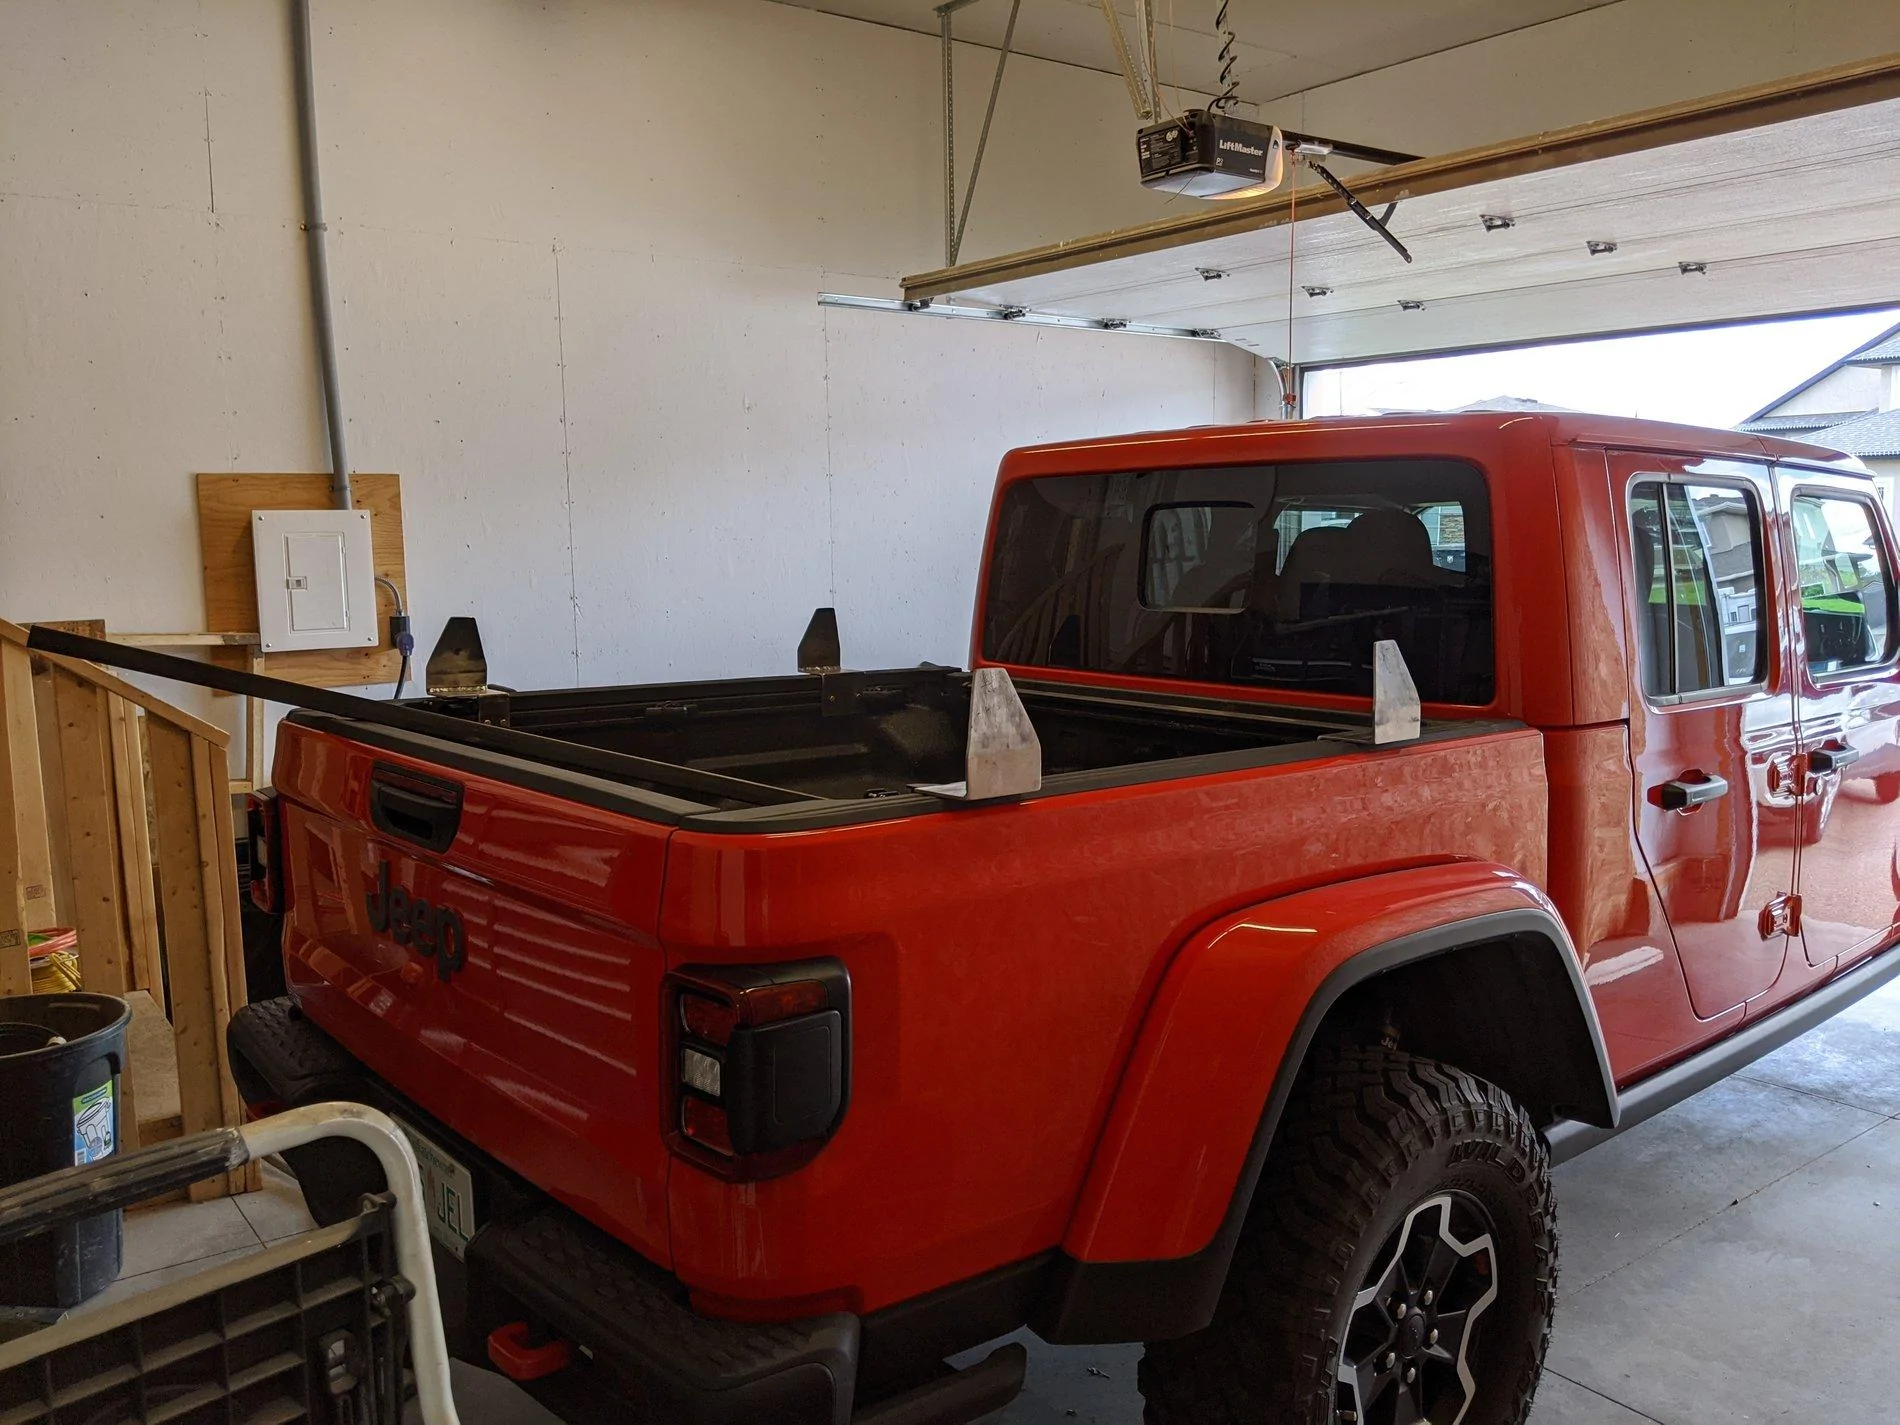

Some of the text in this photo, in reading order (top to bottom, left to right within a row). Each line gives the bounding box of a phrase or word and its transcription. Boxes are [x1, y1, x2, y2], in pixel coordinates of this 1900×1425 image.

[1219, 139, 1263, 156] LiftMaster
[366, 859, 463, 983] Jeep
[438, 1182, 469, 1241] JEL
